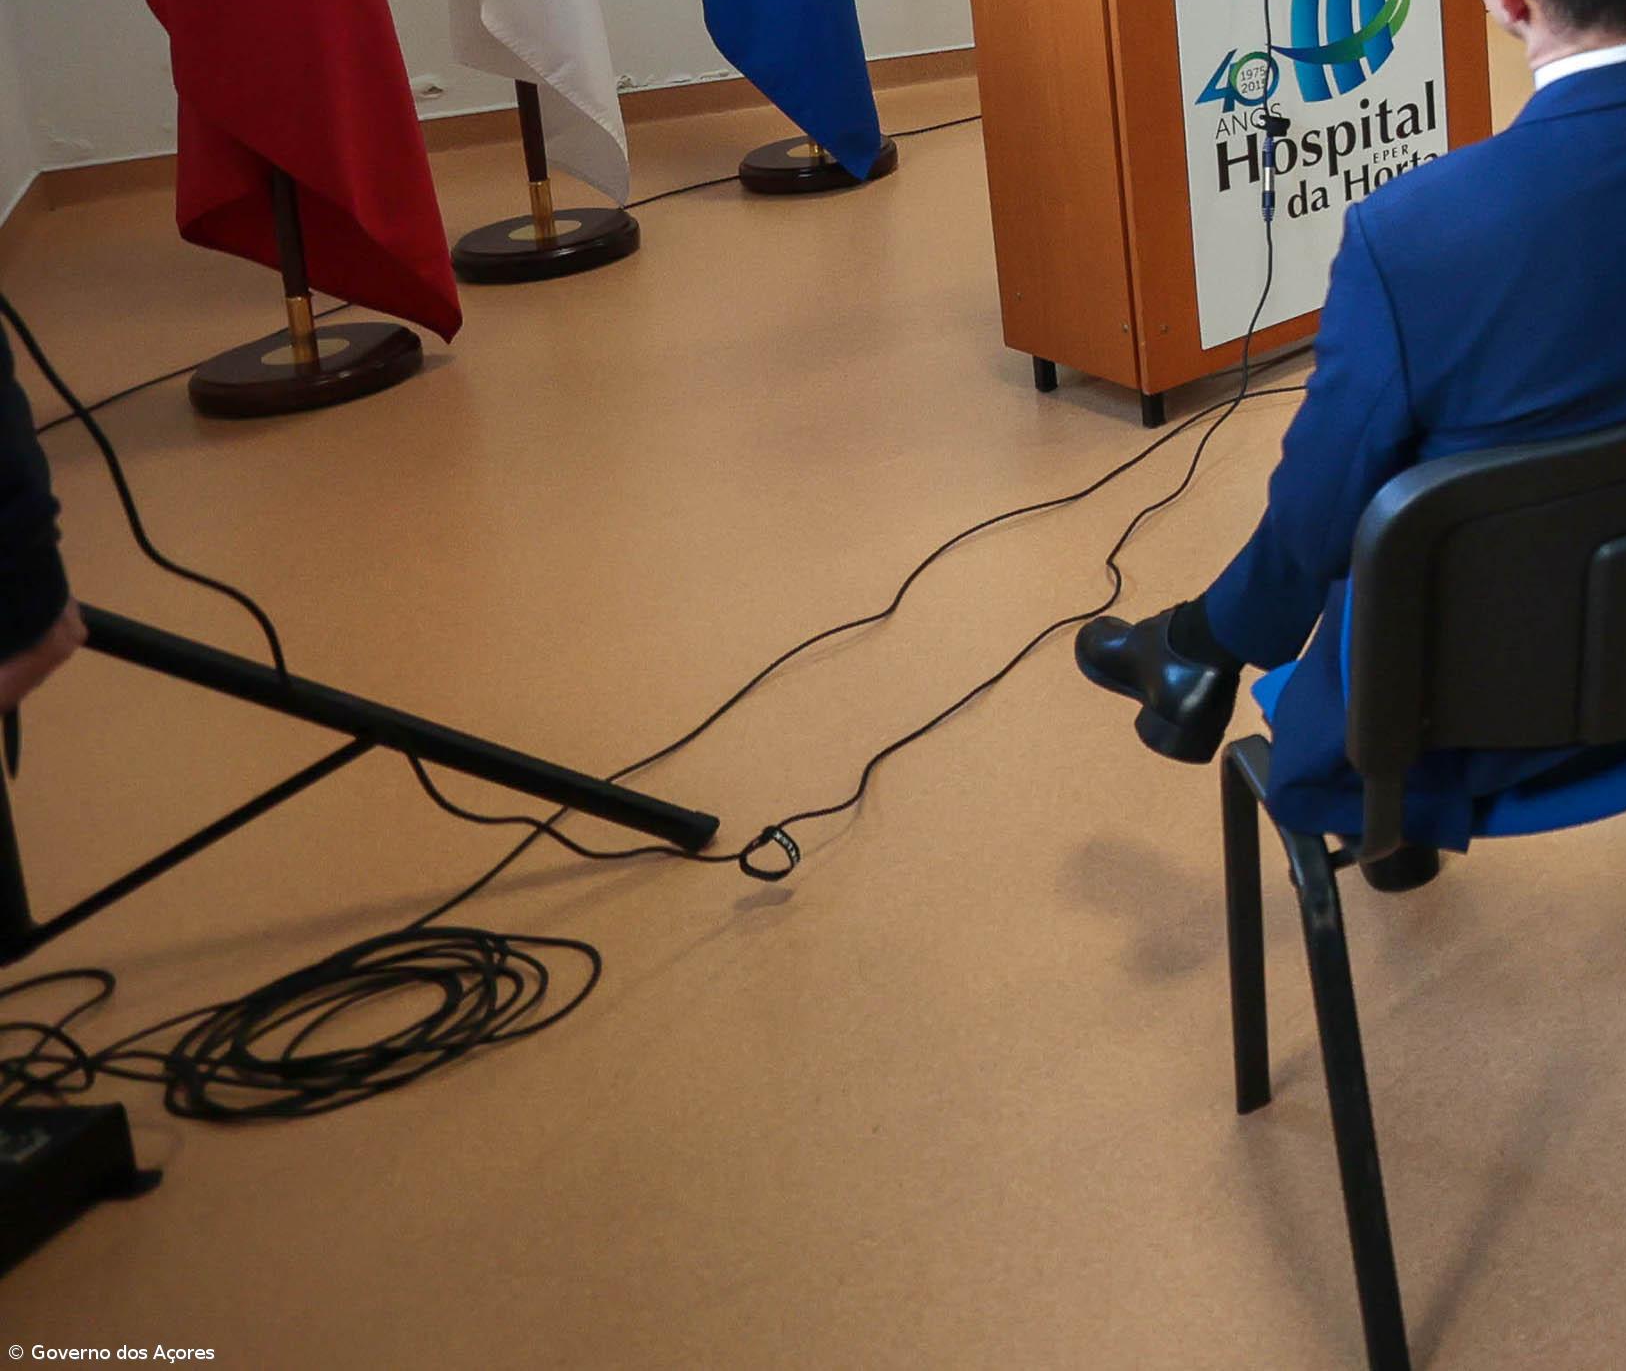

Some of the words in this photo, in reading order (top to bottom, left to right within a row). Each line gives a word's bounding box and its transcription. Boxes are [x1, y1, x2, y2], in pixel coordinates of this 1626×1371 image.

[1216, 80, 1437, 192] Hospital
[1373, 144, 1409, 164] EPER
[1287, 179, 1331, 219] da
[1343, 149, 1438, 202] Hort
